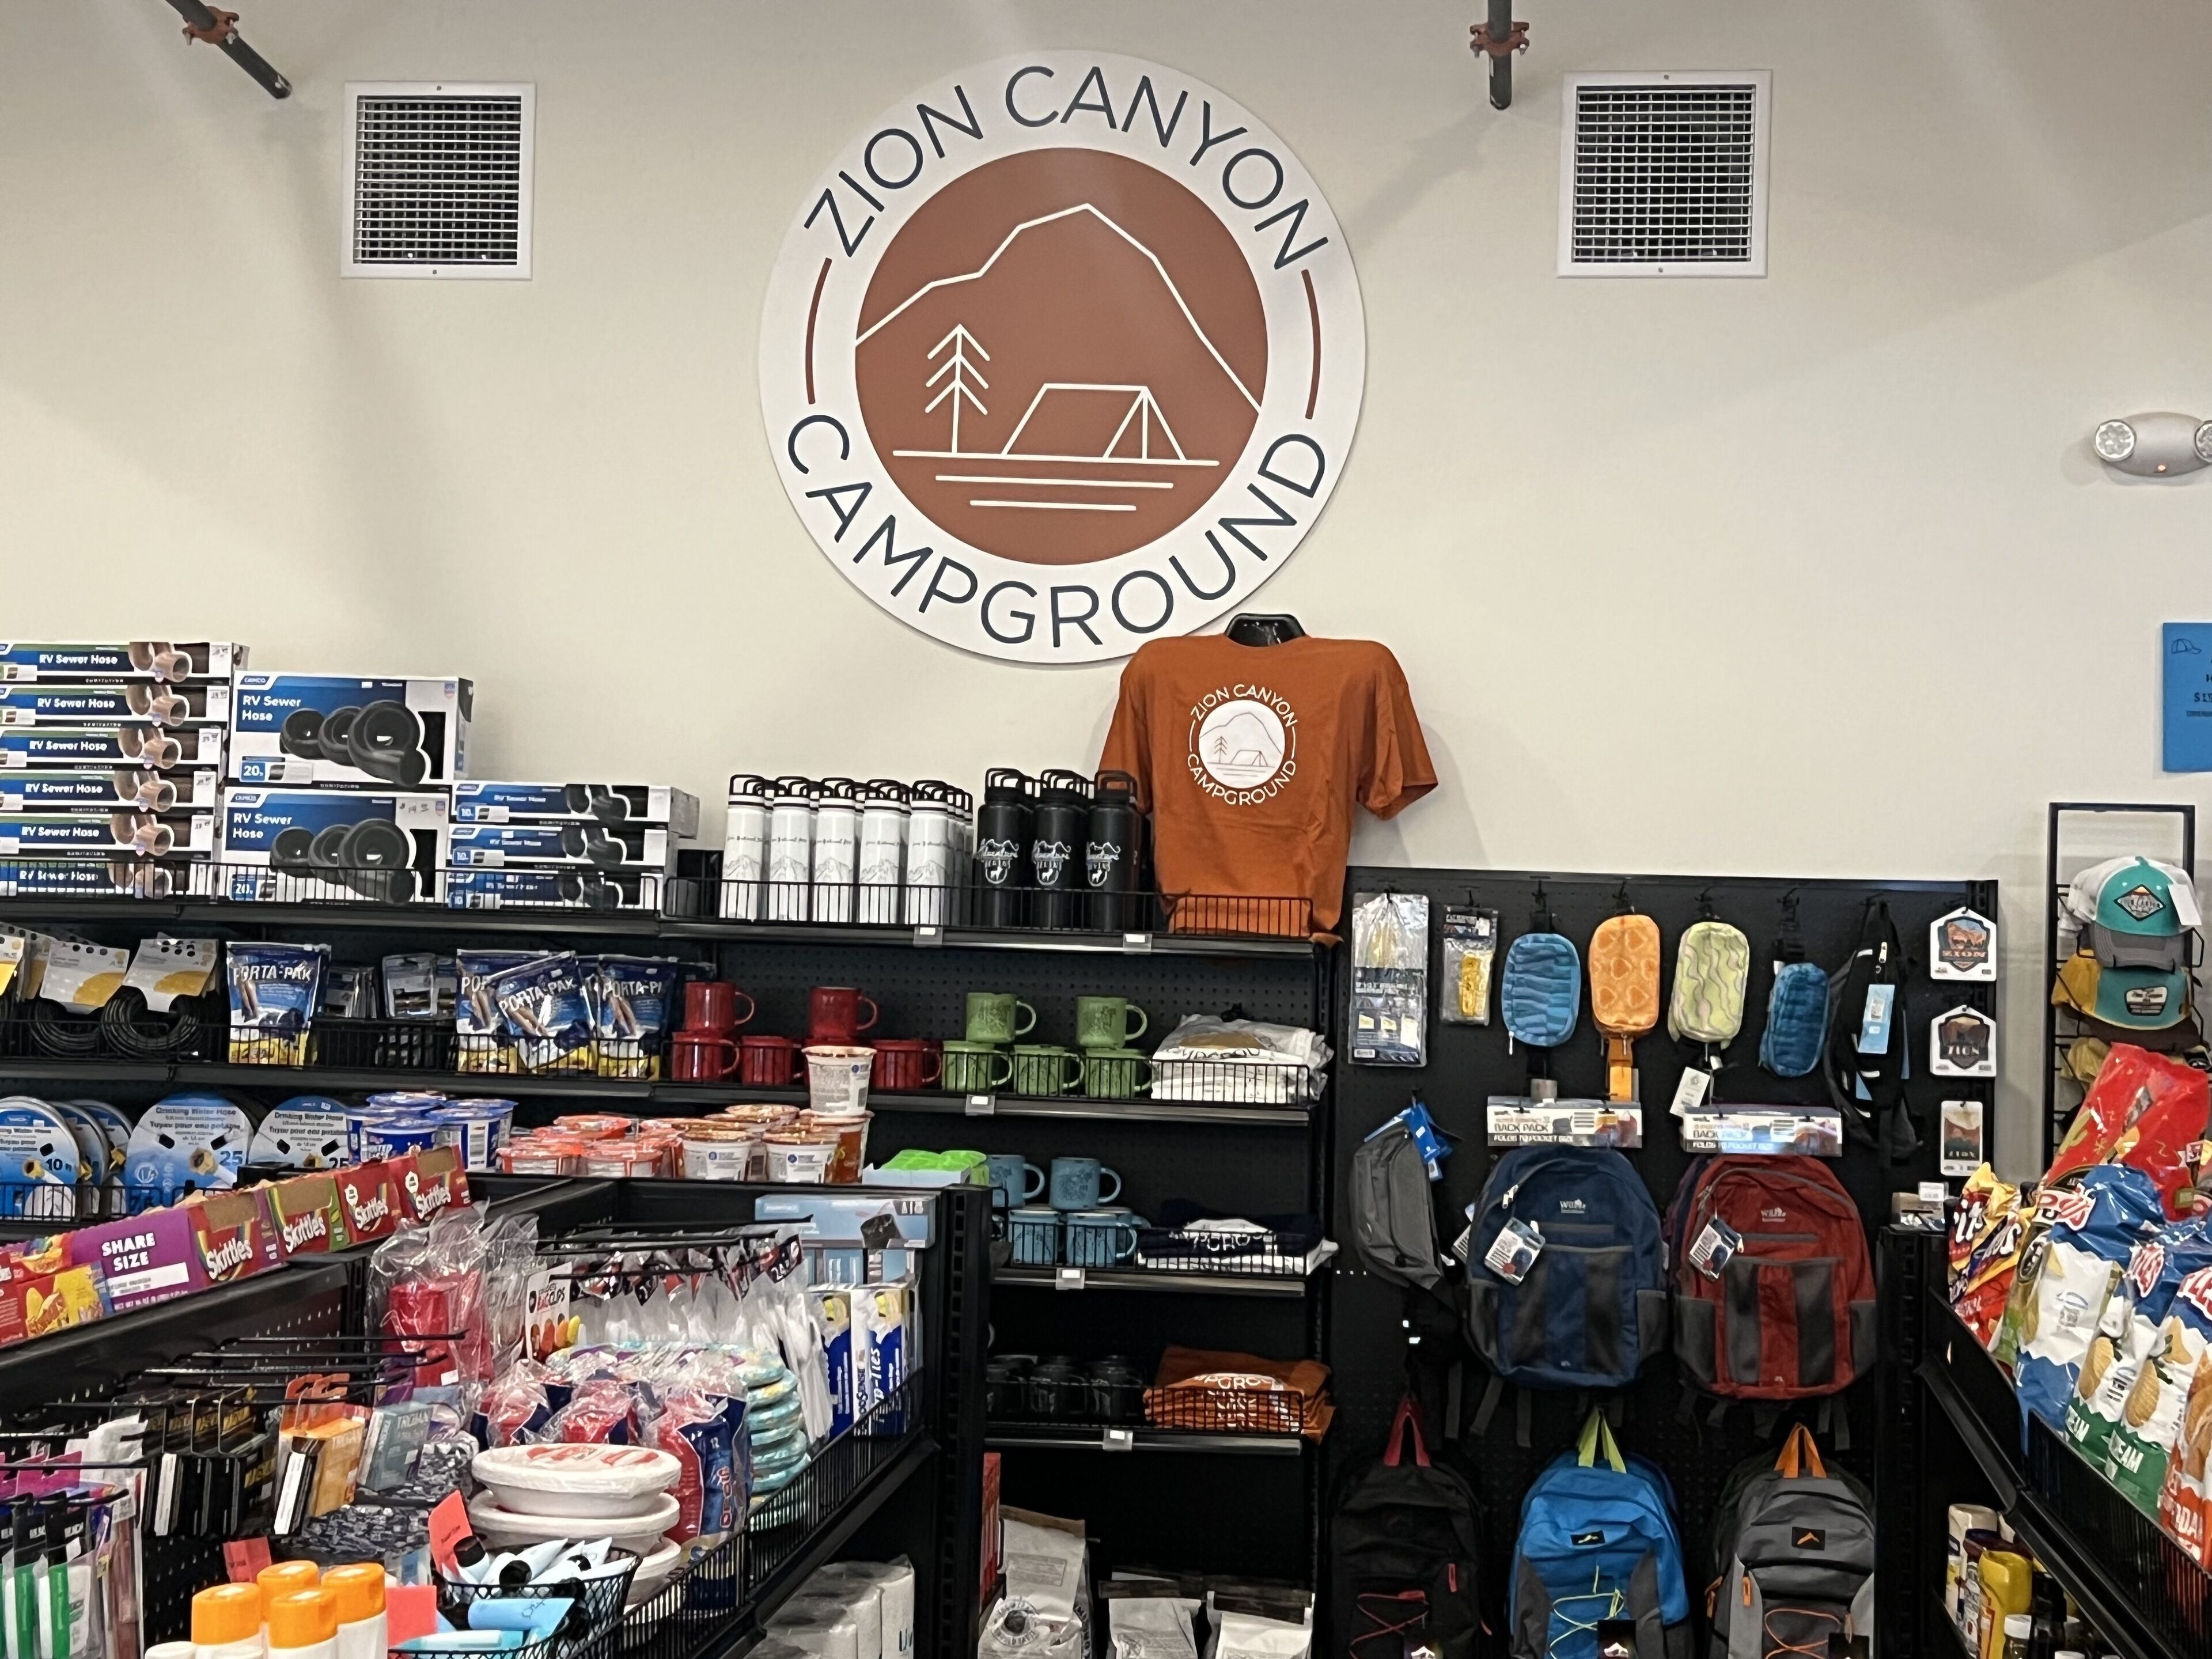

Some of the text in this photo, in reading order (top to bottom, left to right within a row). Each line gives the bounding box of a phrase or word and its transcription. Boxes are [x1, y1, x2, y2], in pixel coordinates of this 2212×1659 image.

[804, 65, 1328, 270] ZION CANYON
[787, 414, 1325, 648] CAMPGROUND
[39, 654, 118, 664] RV Sewer Hose
[37, 698, 115, 708] RV Sewer Hose
[243, 695, 301, 707] RV Sewer
[1190, 684, 1298, 727] ZION CANYON
[242, 710, 273, 721] Hose
[29, 741, 43, 750] RV
[81, 741, 107, 751] Hose
[1187, 753, 1296, 805] CAMPGROUND
[25, 783, 103, 793] RV Sewer Hose
[233, 813, 292, 824] RV Sewer
[21, 827, 36, 836] RV
[73, 827, 100, 836] Hose
[233, 828, 264, 839] Hose
[219, 1150, 243, 1165] 25
[416, 1184, 451, 1219] Skittles
[355, 1197, 388, 1229] Skittles
[283, 1214, 327, 1253] Skittles
[101, 1232, 156, 1256] SHARE
[113, 1251, 149, 1271] SIZE
[206, 1237, 253, 1279] Skittles
